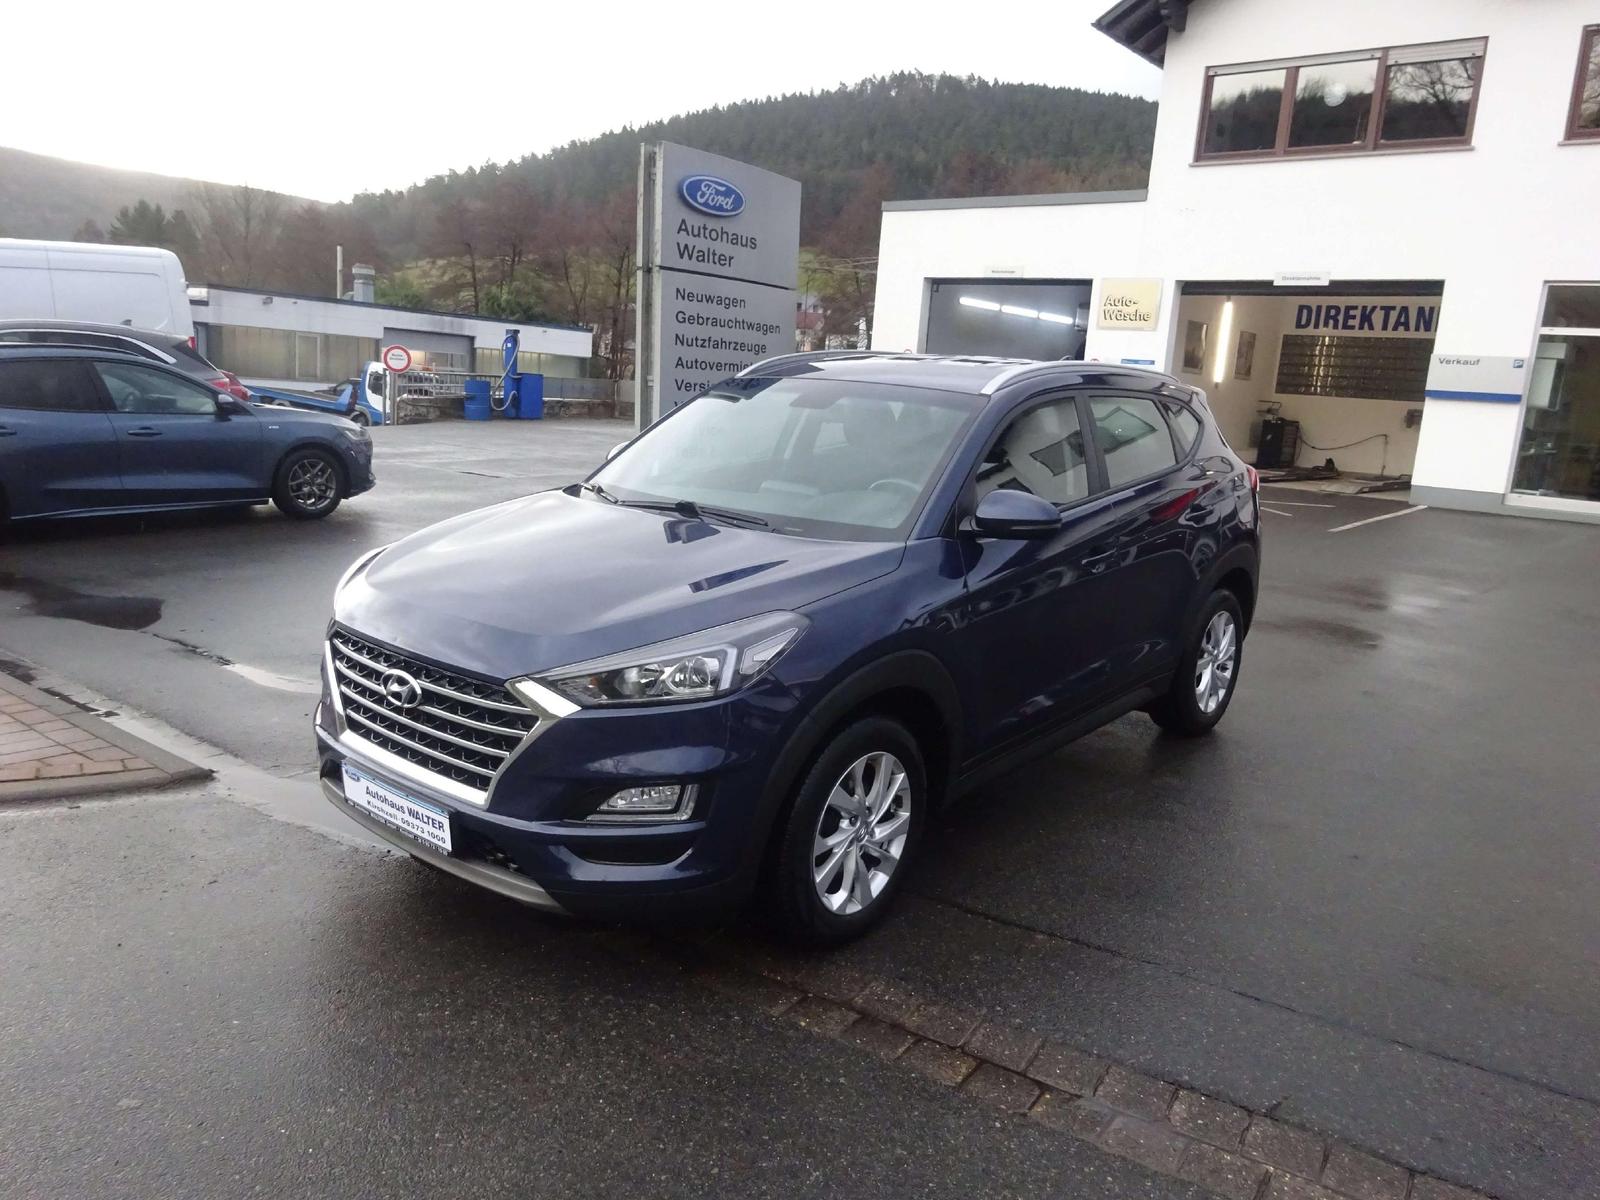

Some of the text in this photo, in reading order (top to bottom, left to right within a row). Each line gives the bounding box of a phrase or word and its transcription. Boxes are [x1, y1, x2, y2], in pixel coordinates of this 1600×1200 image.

[696, 180, 736, 210] Ford
[676, 217, 758, 250] Autohaus
[676, 241, 735, 268] Walter
[675, 287, 746, 309] Neuwagen
[1103, 295, 1140, 307] Auto-
[675, 310, 781, 336] Gebrauchtwagen
[1103, 308, 1152, 322] Wäsche
[1295, 304, 1440, 333] DIREKTAN
[674, 333, 767, 355] Nutzfahrzeuge
[1438, 357, 1481, 366] Verkauf
[365, 785, 445, 832] Autohaus WALTER
